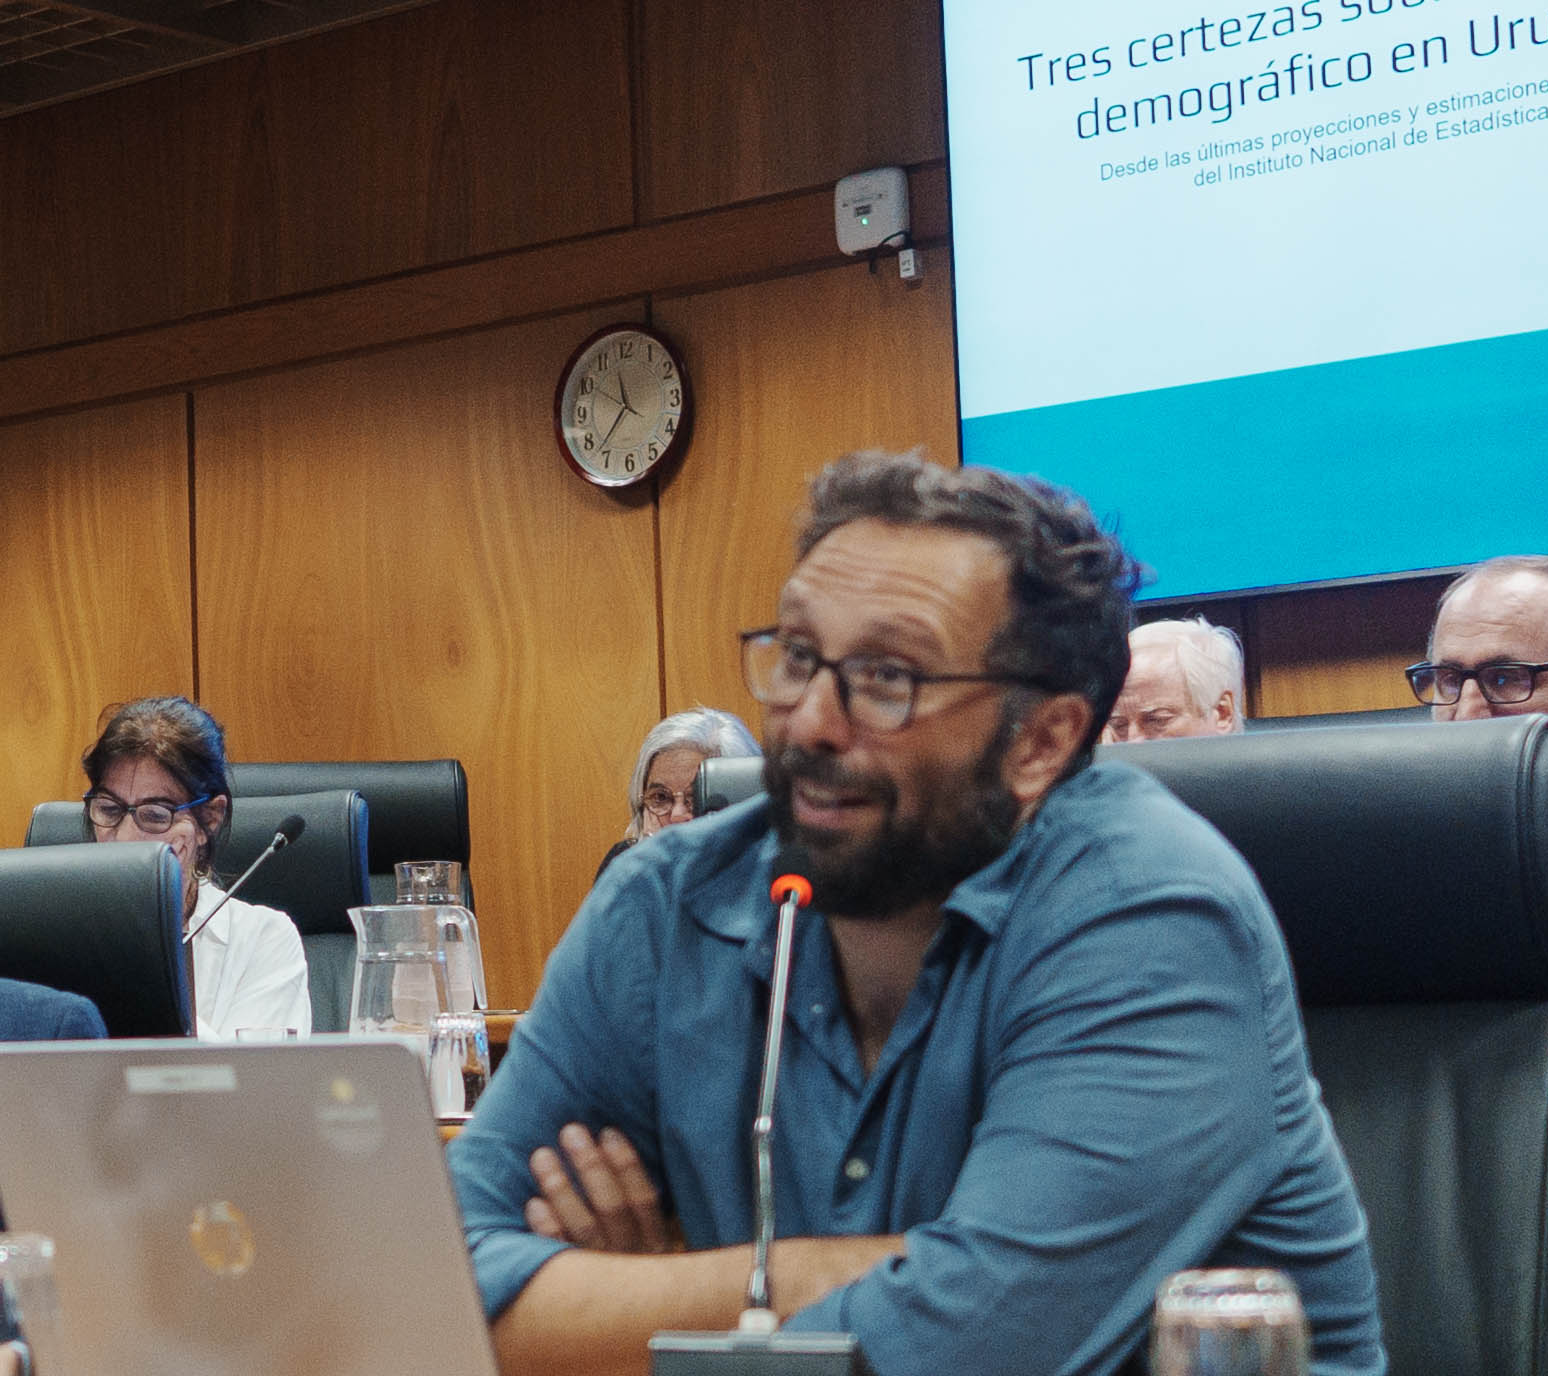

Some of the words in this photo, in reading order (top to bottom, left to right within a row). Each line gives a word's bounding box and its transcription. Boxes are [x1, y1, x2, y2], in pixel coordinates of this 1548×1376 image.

[1016, 45, 1112, 91] Tres
[1076, 52, 1373, 140] demográfico
[1391, 35, 1449, 74] en
[1099, 155, 1160, 182] Desde
[1164, 150, 1192, 169] las
[1196, 138, 1265, 163] últimas
[1271, 109, 1402, 149] proyecciones
[1407, 106, 1420, 125] y
[1193, 163, 1223, 187] del
[1228, 153, 1304, 181] Instituto
[1309, 131, 1397, 165] Nacional
[1402, 127, 1429, 147] de
[619, 341, 633, 359] 12
[647, 343, 653, 361] 1
[598, 353, 608, 371] 11
[663, 361, 673, 380] 2
[580, 376, 594, 395] 10
[670, 388, 680, 407] 3
[577, 406, 587, 424] 9
[665, 418, 676, 436] 4
[584, 432, 594, 451] 8
[602, 450, 611, 468] 7
[648, 442, 658, 461] 5
[625, 453, 635, 472] 6
